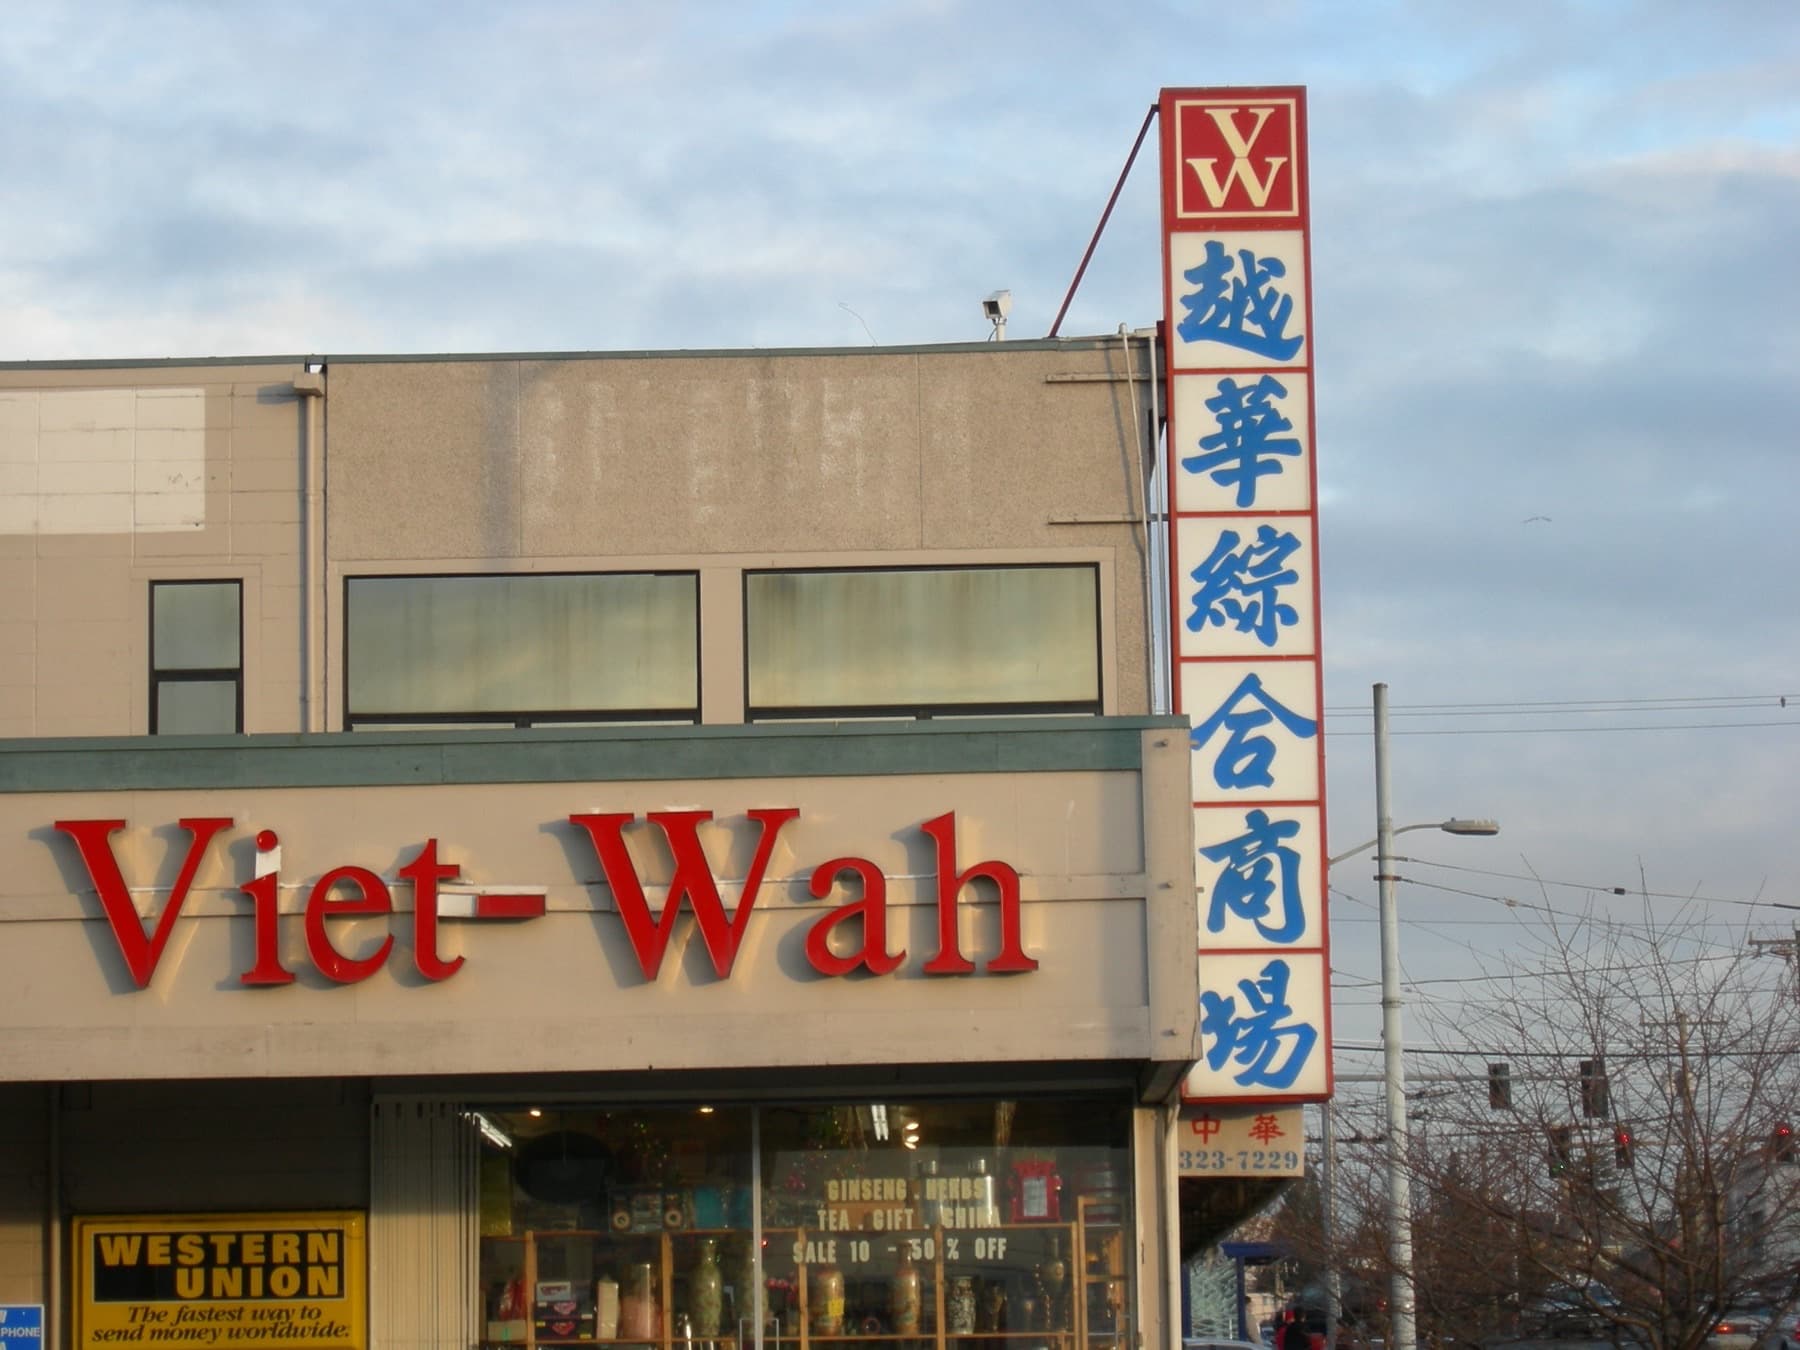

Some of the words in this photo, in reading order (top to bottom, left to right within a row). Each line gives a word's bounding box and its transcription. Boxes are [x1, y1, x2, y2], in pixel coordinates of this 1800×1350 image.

[54, 810, 1039, 989] Viet-Wah
[1180, 1150, 1298, 1171] 323-7229
[827, 1179, 908, 1201] GINSENG
[817, 1209, 850, 1231] TEA
[872, 1208, 914, 1230] GIFT
[99, 1233, 339, 1266] WESTERN
[792, 1240, 837, 1263] SALE
[849, 1240, 870, 1262] 10
[974, 1237, 1008, 1260] OFF
[176, 1266, 339, 1298] UNION
[128, 1306, 168, 1324] The
[172, 1305, 245, 1327] fastest
[250, 1307, 296, 1322] way
[300, 1305, 322, 1320] to
[92, 1325, 145, 1342] send
[149, 1327, 221, 1344] money
